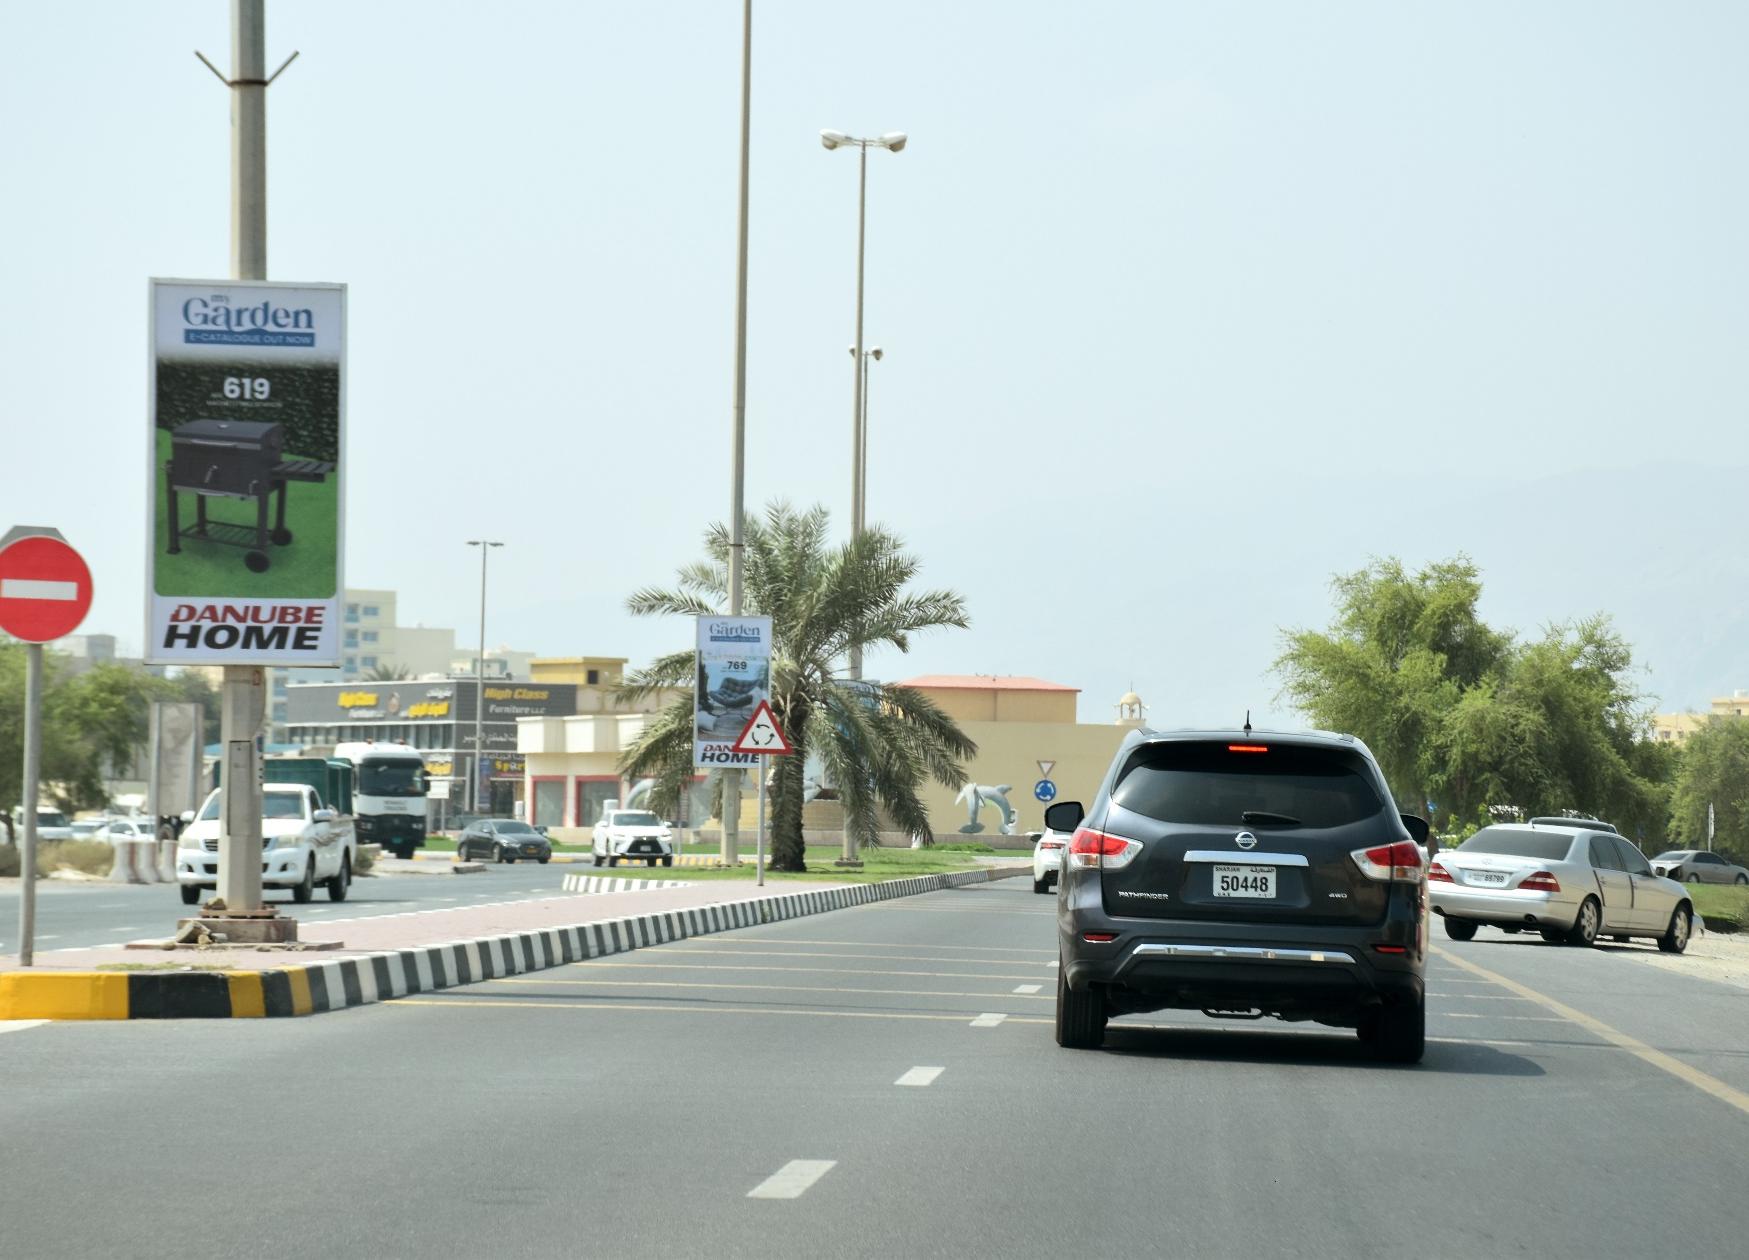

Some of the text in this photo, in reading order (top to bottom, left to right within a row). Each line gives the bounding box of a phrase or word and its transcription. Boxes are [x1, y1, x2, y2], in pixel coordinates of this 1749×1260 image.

[182, 297, 314, 331] Garden
[189, 333, 313, 345] E-CATALOGUE OUT NOW
[223, 376, 271, 401] 619
[169, 604, 327, 625] DANUBE
[709, 623, 760, 637] Garden
[163, 624, 324, 651] HOME
[727, 660, 748, 670] 769
[484, 687, 550, 701] High Class
[489, 704, 531, 714] Furniture
[700, 753, 760, 764] HOME
[1220, 875, 1269, 893] 50448
[1118, 891, 1169, 900] PATHFINDER
